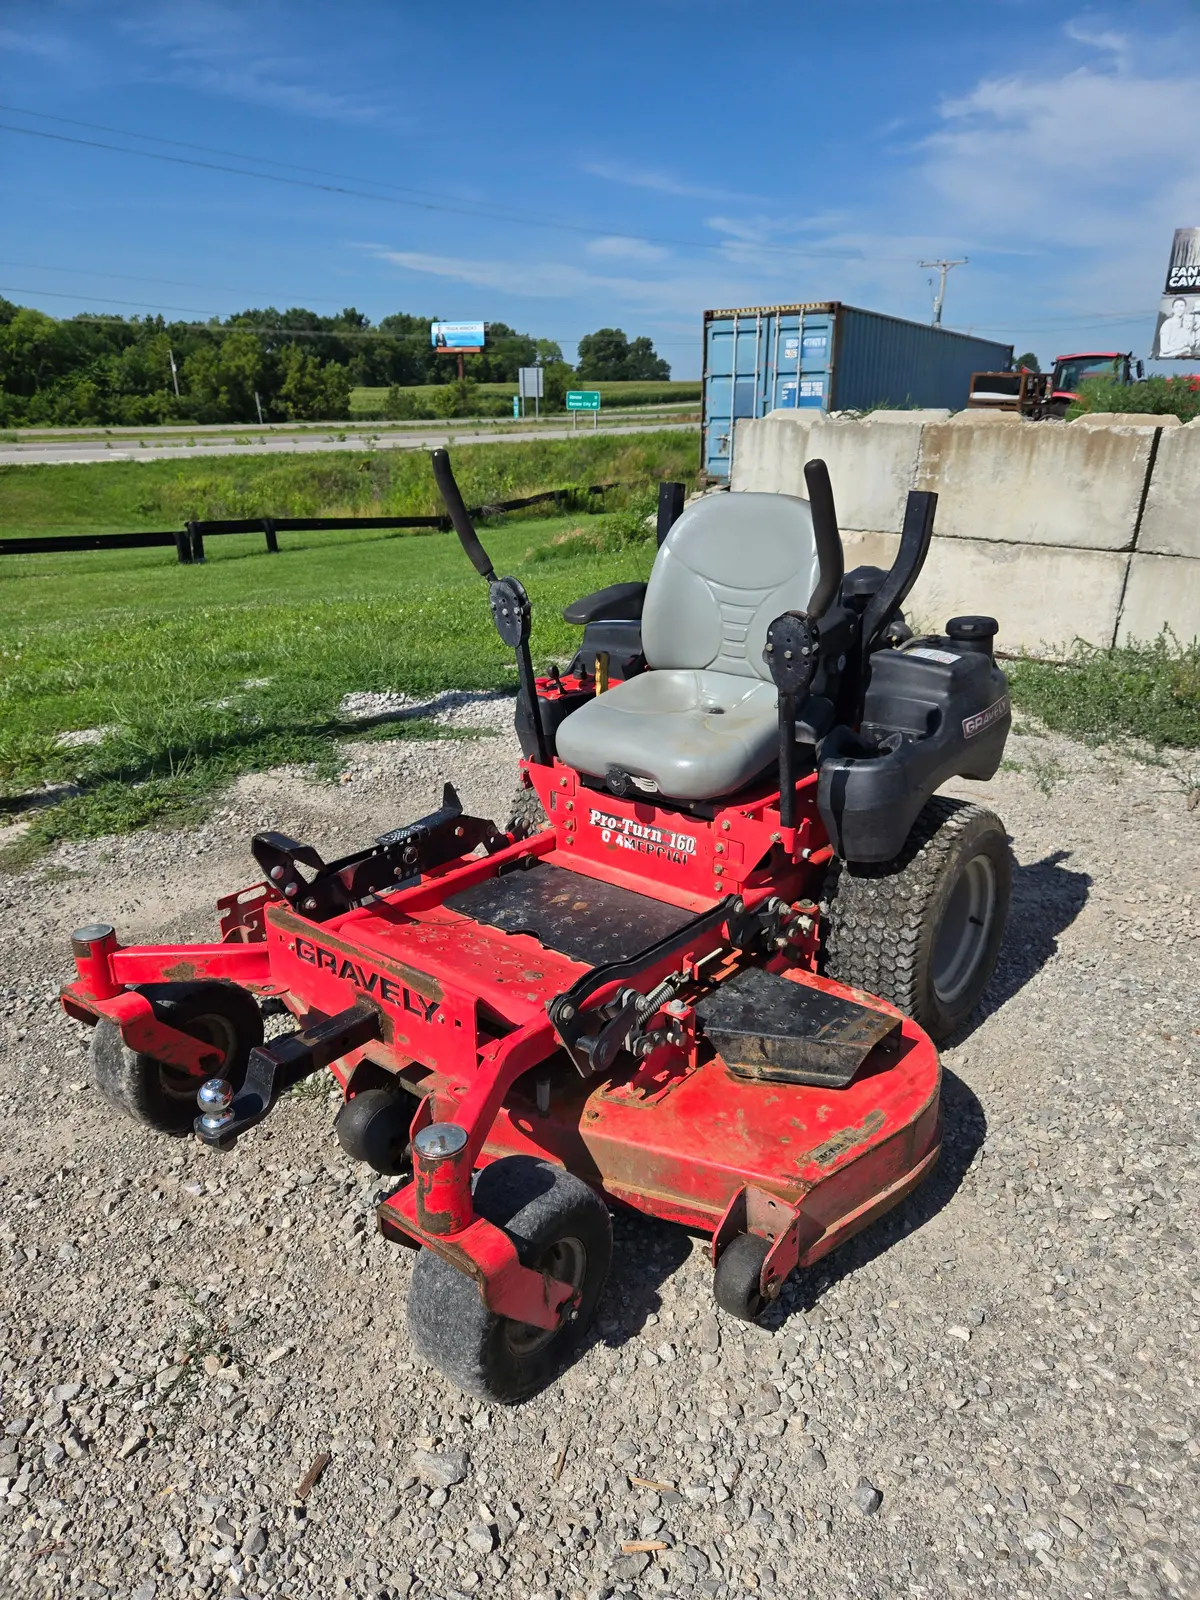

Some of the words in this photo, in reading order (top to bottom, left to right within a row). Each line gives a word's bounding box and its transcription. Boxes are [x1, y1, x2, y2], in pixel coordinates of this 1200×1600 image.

[1171, 266, 1200, 277] FAN
[965, 701, 1006, 734] GRAVELY
[589, 809, 662, 843] Pro-Turn
[669, 833, 696, 854] 160
[295, 937, 440, 1024] GRAVELY
